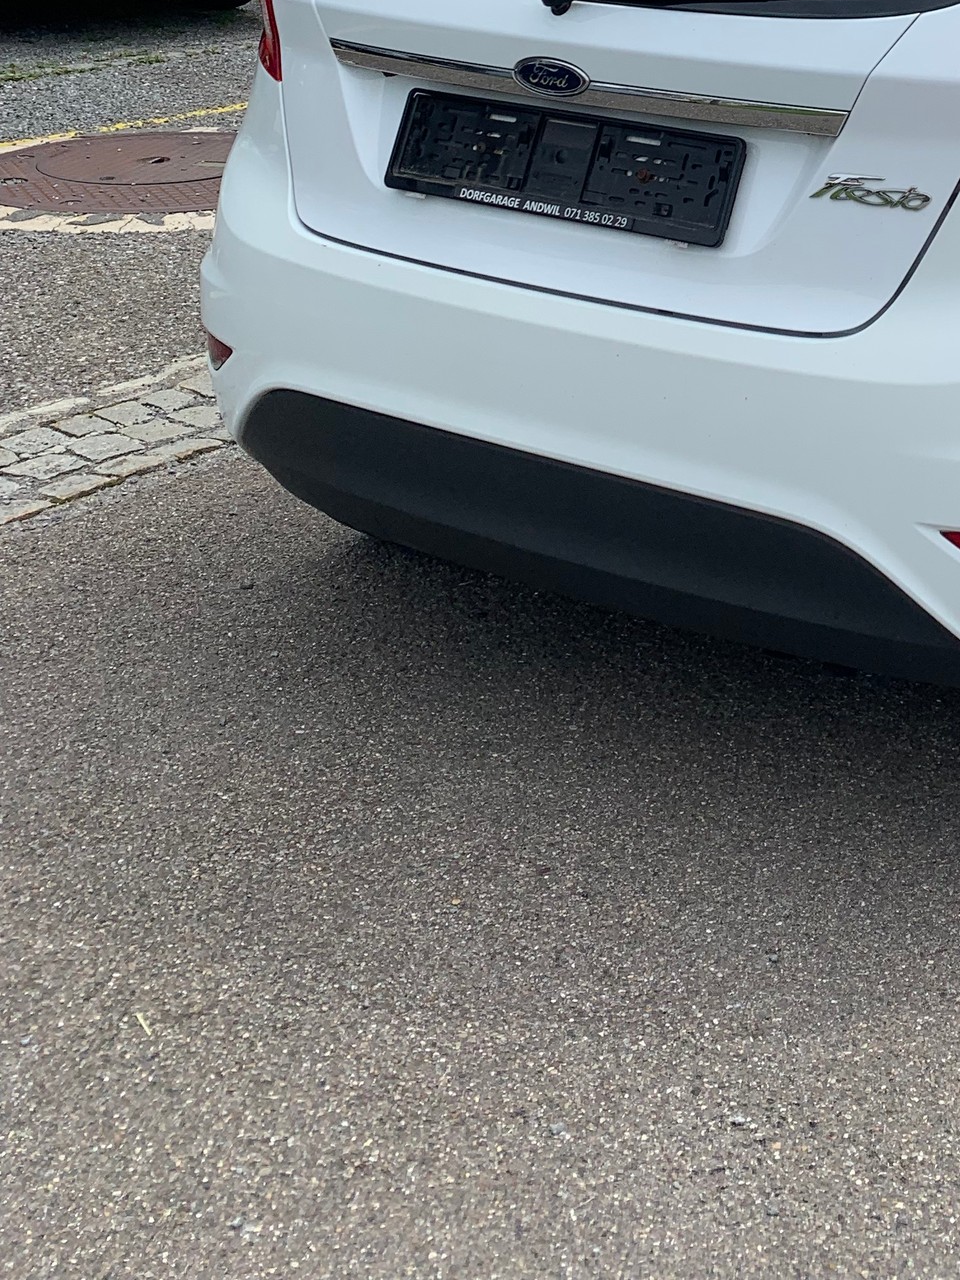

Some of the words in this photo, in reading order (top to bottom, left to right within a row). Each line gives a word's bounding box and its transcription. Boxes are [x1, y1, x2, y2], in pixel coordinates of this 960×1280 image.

[527, 60, 570, 88] Ford
[459, 187, 521, 209] DORFGARAGE
[523, 202, 561, 216] ANDWIL
[564, 207, 581, 220] 071
[583, 210, 600, 223] 385
[601, 214, 614, 225] 02
[615, 217, 628, 228] 29
[808, 172, 932, 211] Fiesta
